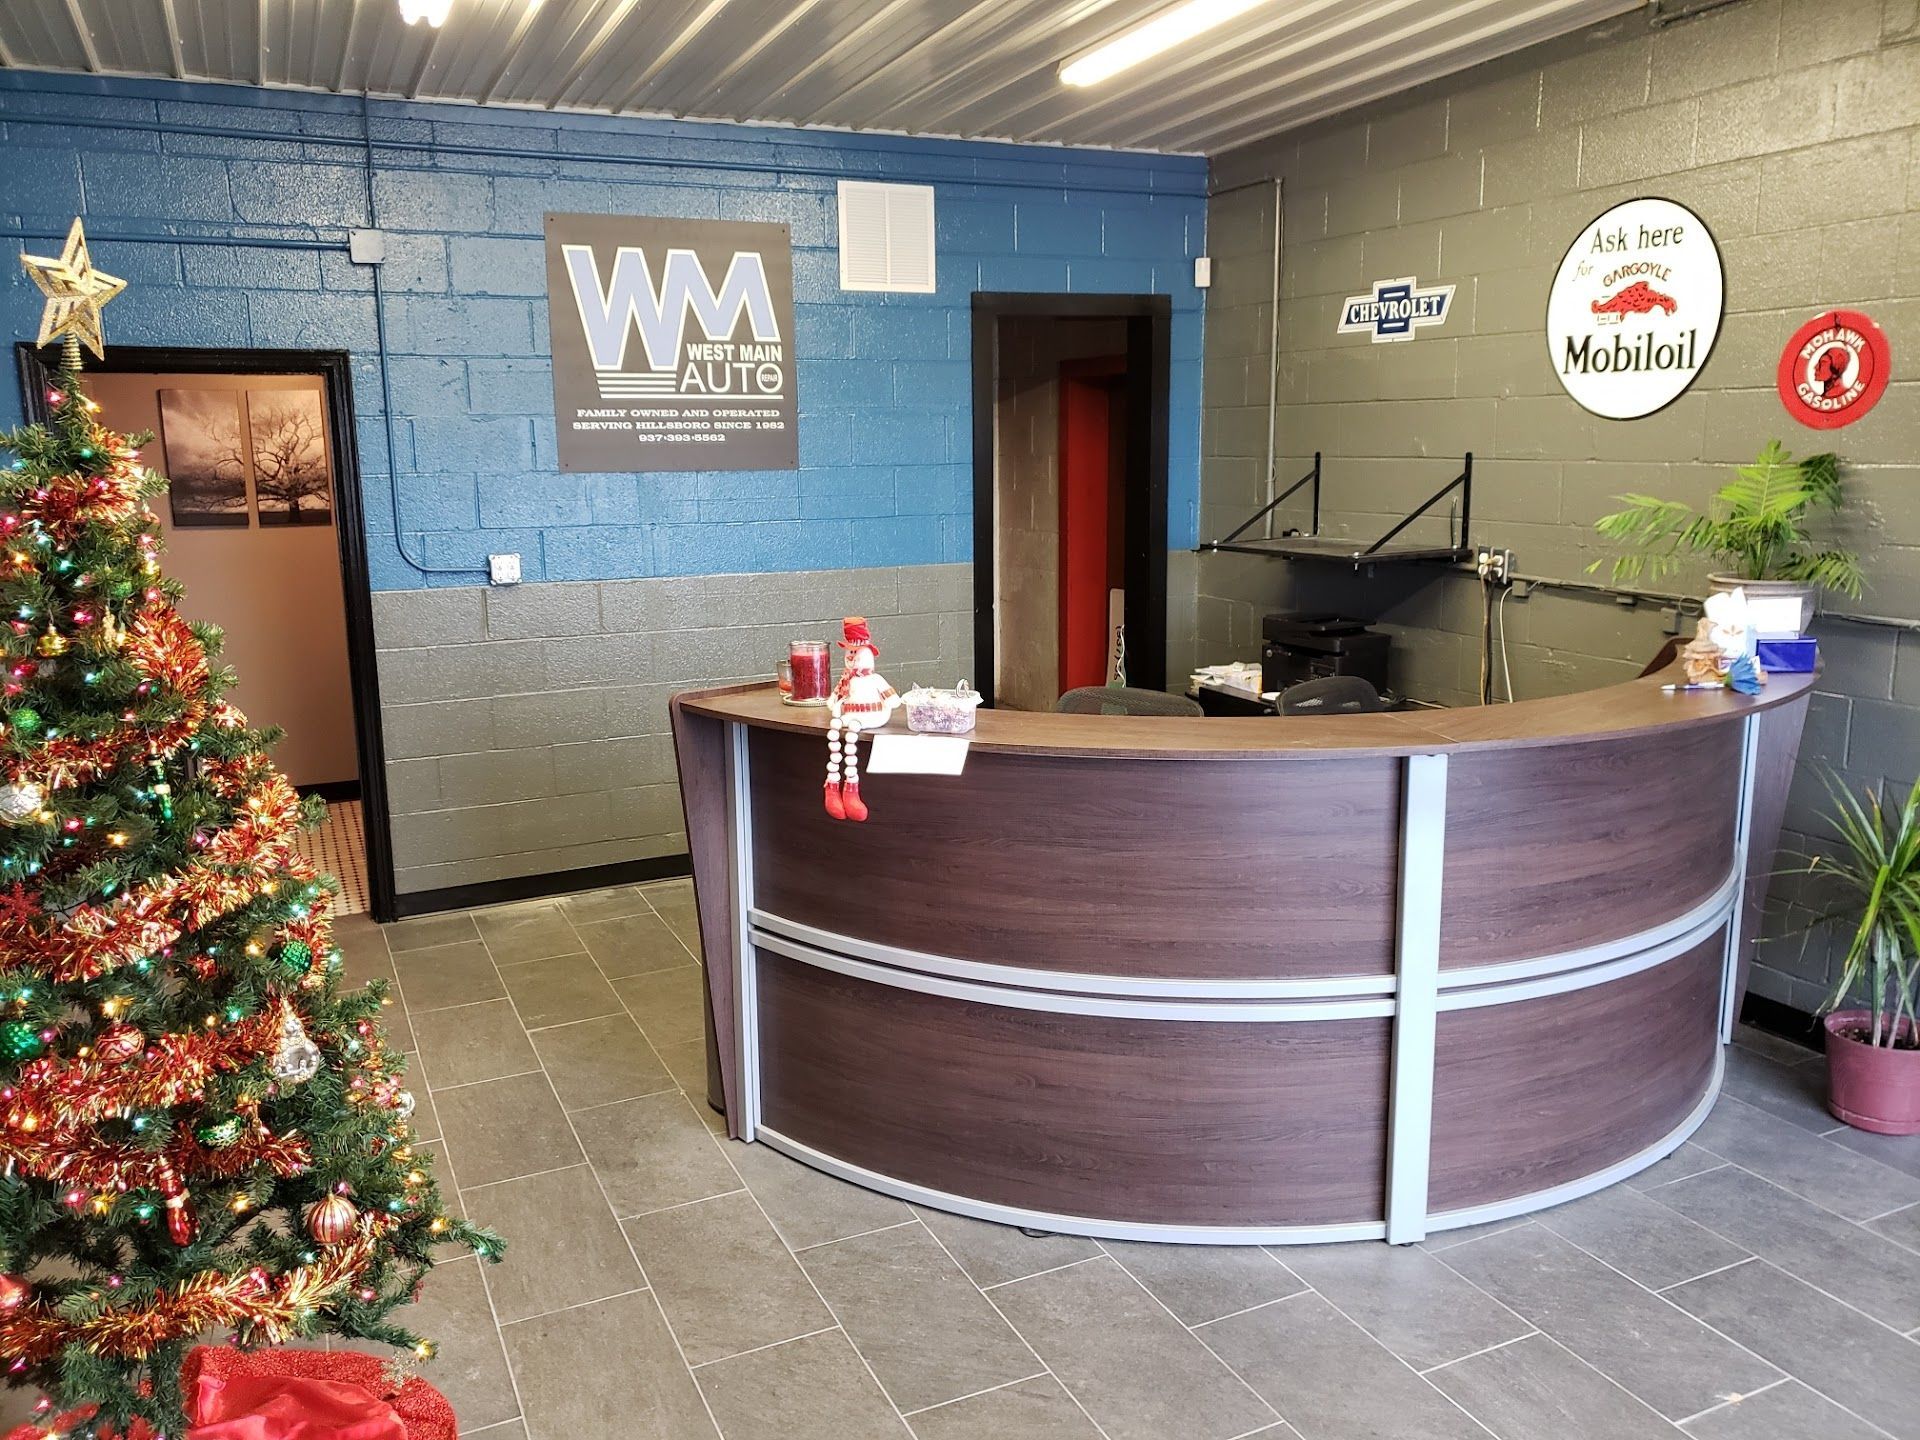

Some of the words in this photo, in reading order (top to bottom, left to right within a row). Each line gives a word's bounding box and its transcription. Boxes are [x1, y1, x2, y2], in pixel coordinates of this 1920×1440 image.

[1590, 225, 1629, 254] Ask
[1638, 224, 1684, 249] here
[1572, 260, 1594, 282] for
[1602, 262, 1672, 288] GARGOYLE
[561, 244, 782, 371] WM
[1350, 296, 1441, 323] CHEVROLET
[686, 343, 735, 361] WEST
[739, 344, 783, 362] MAIN
[1563, 328, 1698, 374] Mobiloil
[1800, 327, 1866, 360] MOHAWK
[679, 362, 784, 394] AUTO
[761, 373, 778, 382] REPAIR
[1798, 380, 1866, 410] GASOLINE
[572, 421, 632, 430] SERVING
[635, 421, 711, 430] HILLSBORO
[714, 421, 752, 429] SINCE
[576, 408, 628, 417] FAMILY
[630, 409, 679, 417] OWNED
[682, 409, 710, 417] AND
[712, 409, 780, 417] OPERATED
